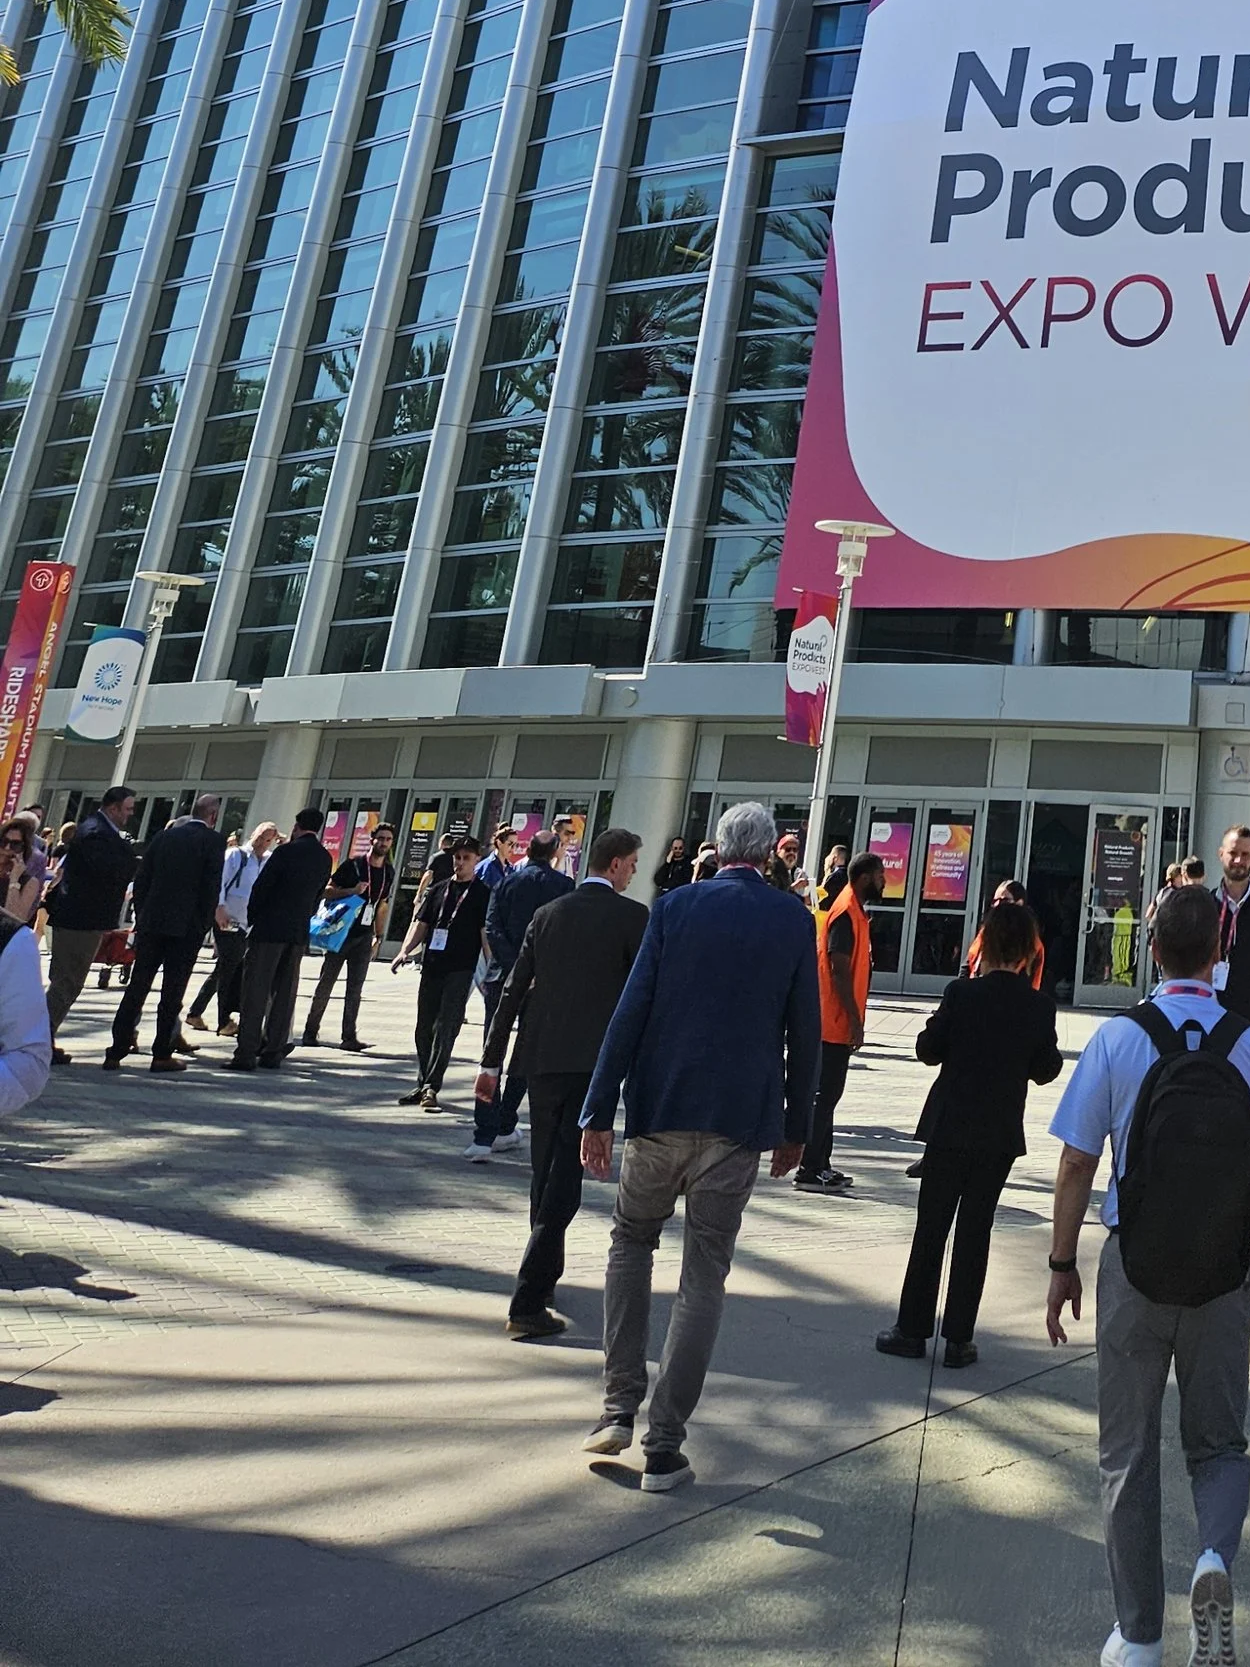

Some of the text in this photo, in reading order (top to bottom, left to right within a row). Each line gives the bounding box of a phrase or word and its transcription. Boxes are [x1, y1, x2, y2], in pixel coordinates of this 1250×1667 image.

[916, 274, 1174, 353] EXPO
[795, 638, 823, 651] Natural
[793, 649, 826, 664] Products
[81, 694, 123, 706] New Hope
[3, 621, 58, 824] ANGEL STADIUM SHUTT
[882, 858, 904, 869] ture!
